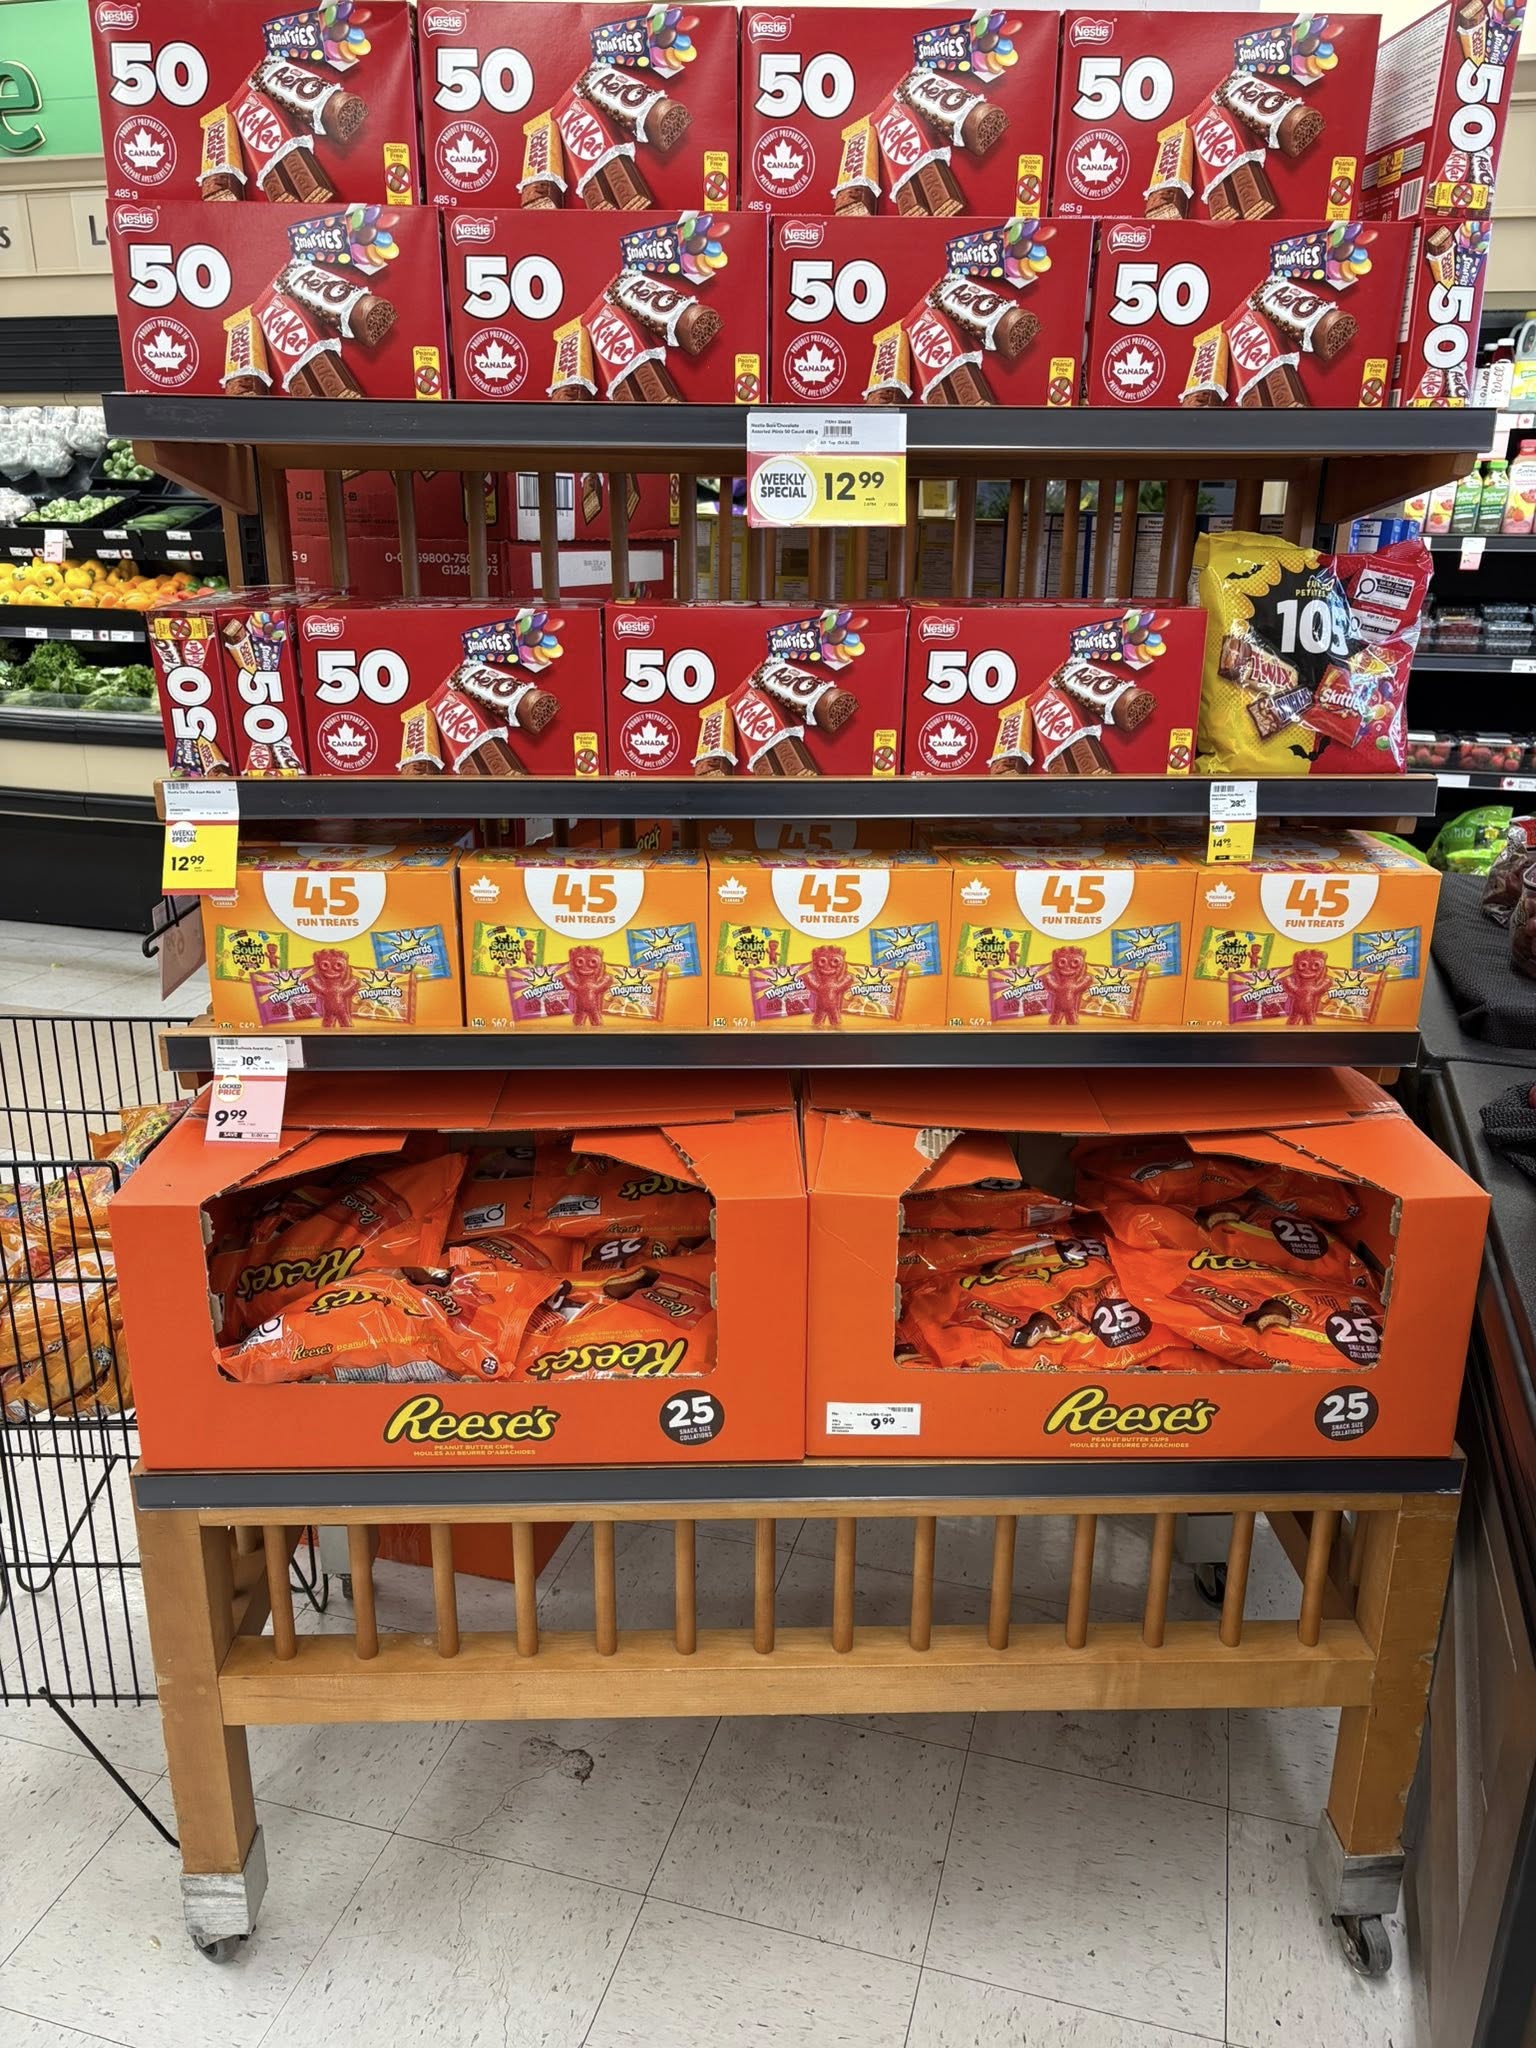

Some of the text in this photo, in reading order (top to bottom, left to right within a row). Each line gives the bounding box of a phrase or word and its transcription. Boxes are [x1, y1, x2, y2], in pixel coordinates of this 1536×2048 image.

[108, 41, 209, 106] 50
[433, 46, 535, 112] 50
[755, 52, 856, 118] 50
[1073, 55, 1175, 120] 50
[1448, 57, 1505, 153] 50
[128, 149, 161, 157] CANADA
[449, 155, 483, 163] CANADA
[766, 161, 800, 169] CANADA
[1080, 163, 1114, 171] CANADA
[126, 243, 233, 308] 50
[461, 255, 564, 319] 50
[786, 258, 888, 323] 50
[1111, 261, 1211, 325] 50
[1423, 282, 1475, 369] 50
[147, 350, 183, 358] CANADA
[478, 361, 513, 369] CANADA
[797, 364, 831, 372] CANADA
[1116, 367, 1150, 375] CANADA
[760, 473, 807, 486] WEEKLY
[760, 487, 807, 498] SPECIAL
[313, 648, 410, 704] 50
[622, 647, 714, 703] 50
[924, 649, 1015, 704] 50
[166, 665, 218, 743] 50
[237, 667, 289, 744] 50
[293, 877, 360, 917] 45
[553, 874, 618, 914] 45
[799, 874, 863, 914] 45
[1042, 875, 1107, 915] 45
[1287, 879, 1351, 918] 45
[297, 918, 360, 927] FUN TREATS
[555, 915, 616, 924] FUN TREATS
[800, 915, 860, 924] FUN TREATS
[1042, 916, 1103, 925] FUN TREATS
[1285, 919, 1345, 928] FUN TREATS
[490, 951, 520, 960] PATCH
[491, 943, 519, 951] SOUR
[735, 951, 764, 960] PATCH
[736, 943, 763, 951] SOUR
[1216, 955, 1245, 964] PATCH
[1218, 947, 1245, 955] SOUR
[1275, 1219, 1319, 1243] 25
[238, 1248, 361, 1298] Reese's
[1094, 1302, 1141, 1335] 25
[1329, 1316, 1379, 1344] 25
[293, 1344, 333, 1361] Reese's
[484, 1358, 496, 1371] 25
[531, 1339, 689, 1380] Reese's
[385, 1394, 560, 1441] Reese's
[666, 1394, 716, 1429] 25
[1045, 1386, 1217, 1433] Reese's
[1322, 1391, 1370, 1423] 25
[679, 1427, 698, 1436] SNACK
[680, 1432, 713, 1441] COLLATIONS
[1331, 1422, 1350, 1430] SNACK
[1331, 1428, 1364, 1437] COLLATIONS
